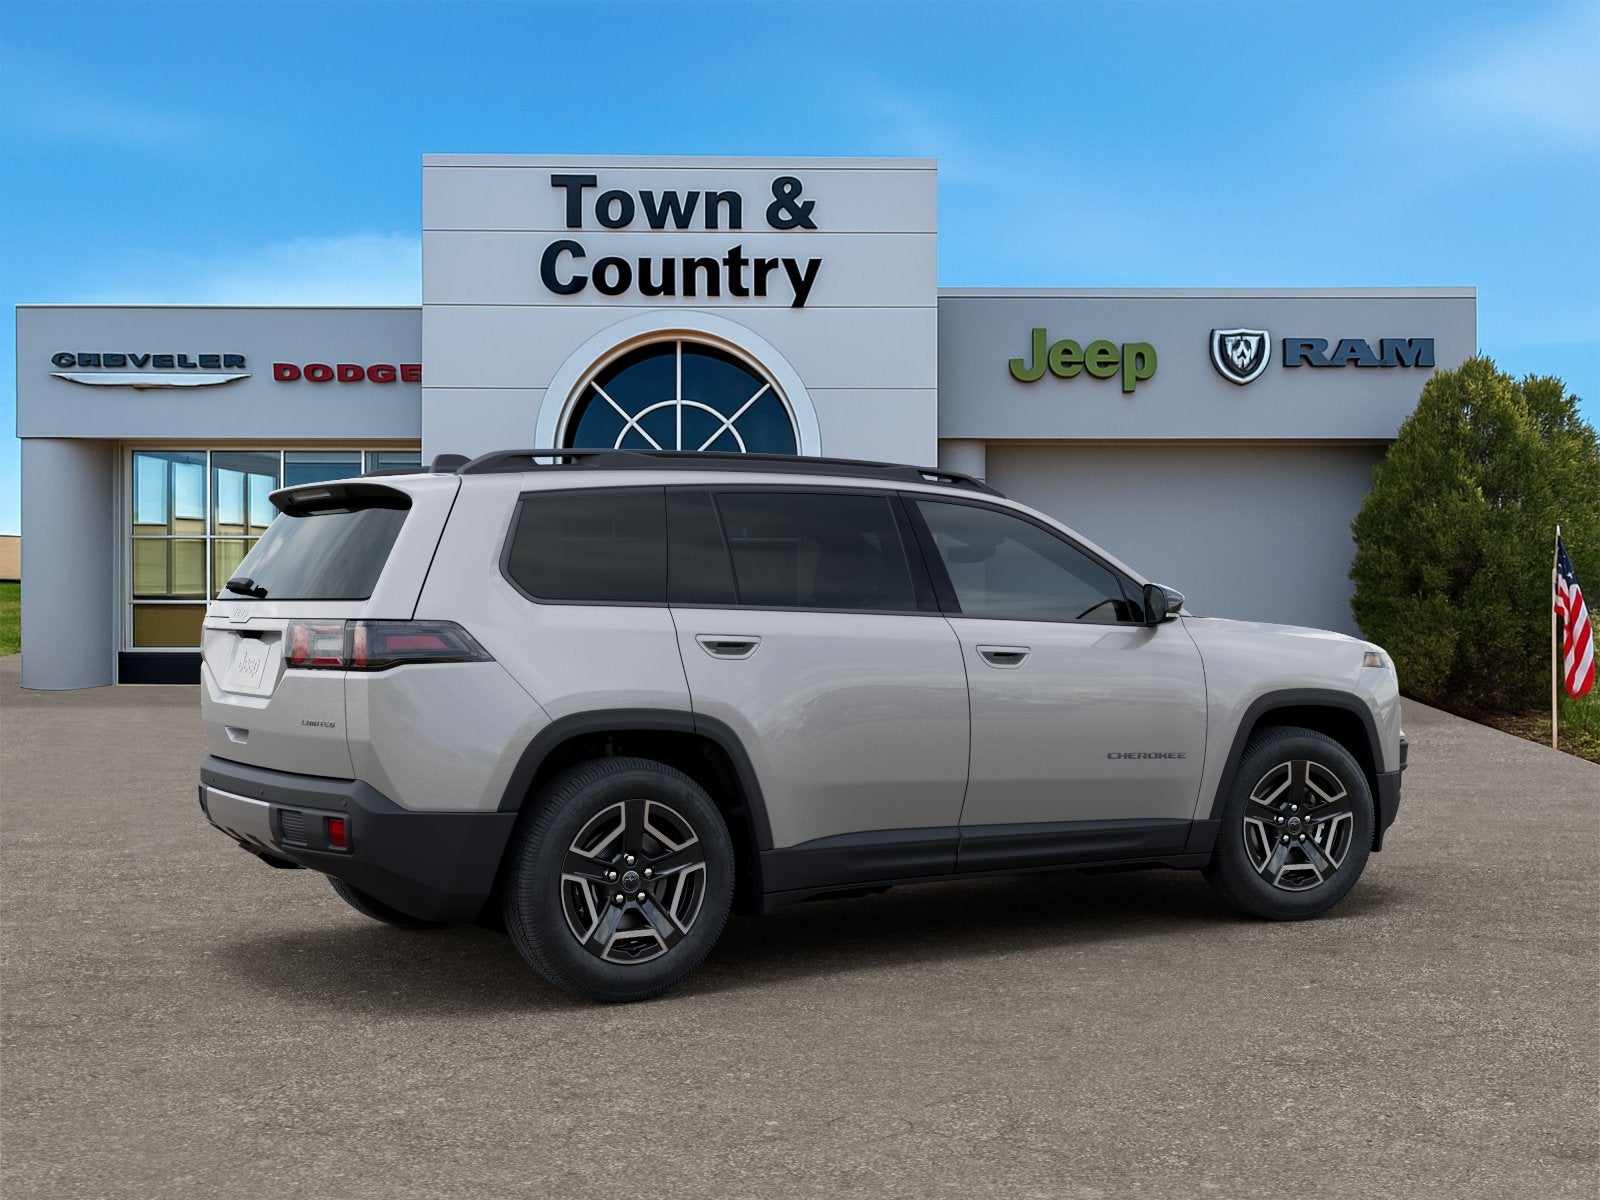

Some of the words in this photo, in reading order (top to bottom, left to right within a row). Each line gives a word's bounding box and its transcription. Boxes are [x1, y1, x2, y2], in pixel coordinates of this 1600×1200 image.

[550, 174, 743, 229] Town
[766, 176, 818, 230] &
[540, 239, 823, 308] Country
[1009, 328, 1158, 393] Jeep
[1283, 337, 1436, 368] RAM
[273, 363, 422, 383] DODGE
[301, 719, 336, 728] LIMITED
[1107, 752, 1187, 760] CHEROKEE
